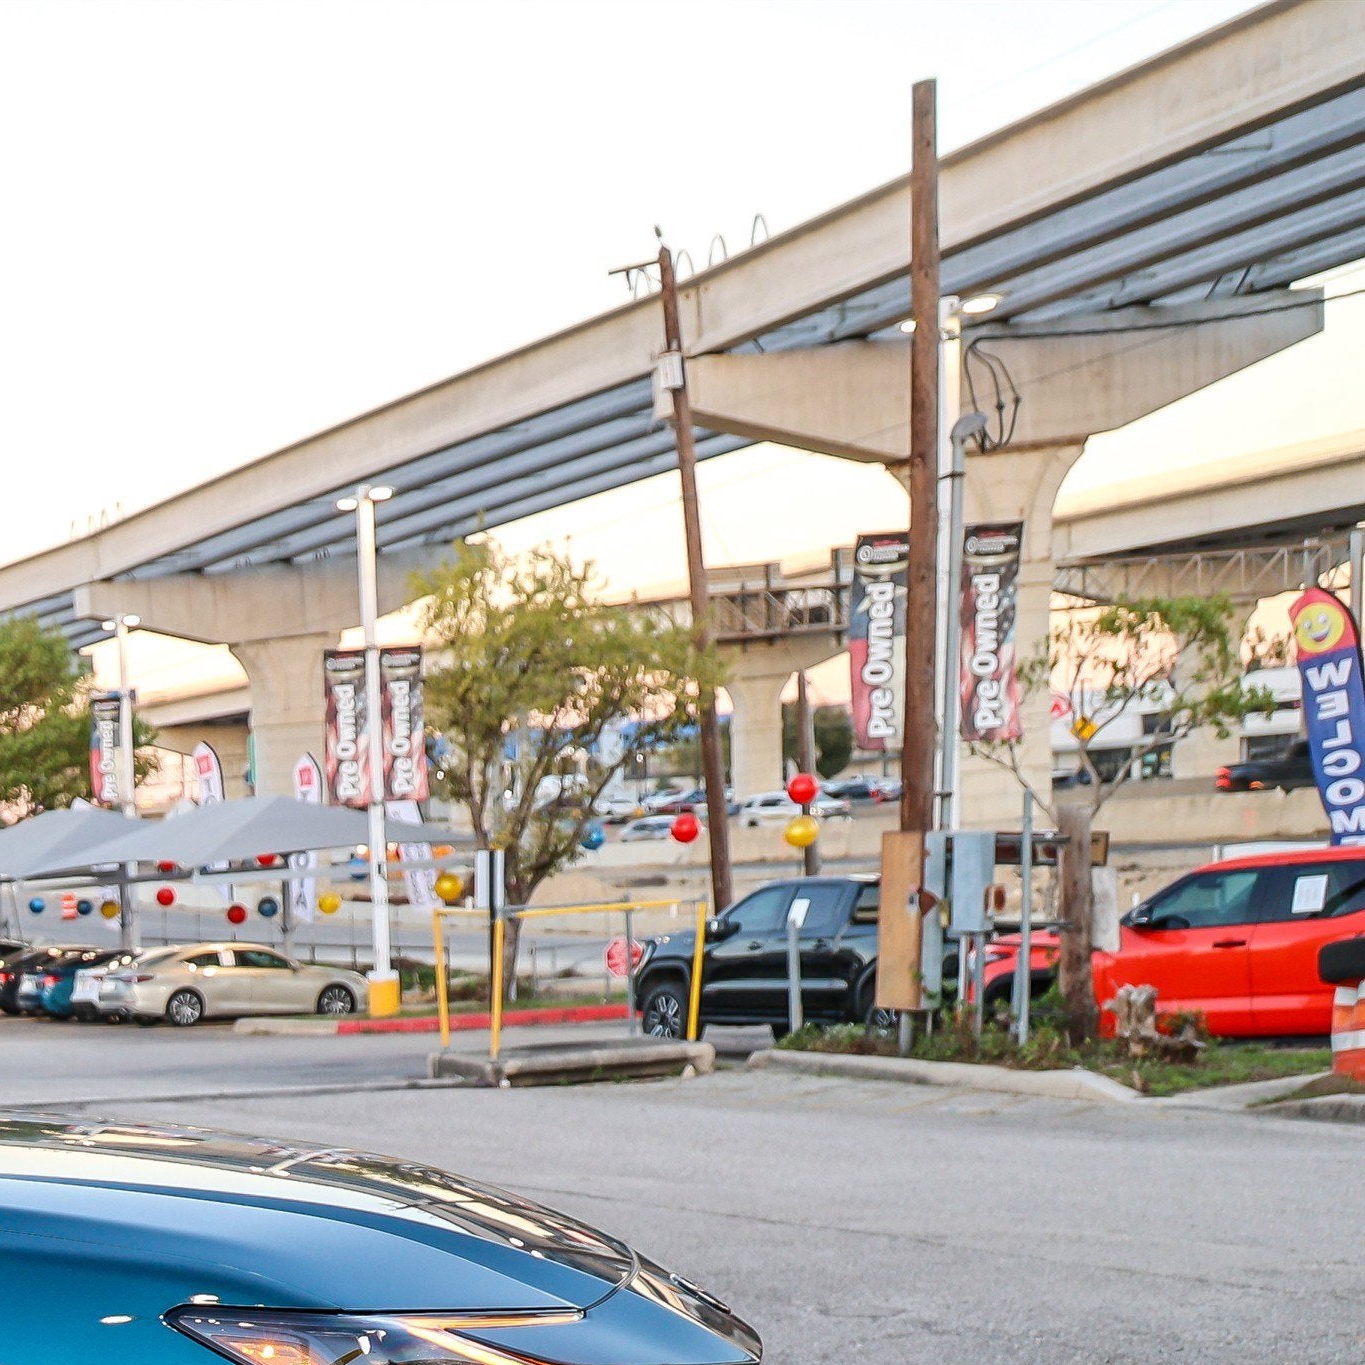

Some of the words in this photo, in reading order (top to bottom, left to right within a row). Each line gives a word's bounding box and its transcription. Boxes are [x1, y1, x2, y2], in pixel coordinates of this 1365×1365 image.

[862, 581, 895, 686] Owned
[970, 573, 1000, 677] Owned
[333, 683, 358, 761] Owned
[387, 680, 412, 758] Owned
[869, 688, 896, 738] Pre
[974, 679, 1004, 730] Pre
[336, 760, 361, 798] Pre
[392, 757, 416, 795] Pre
